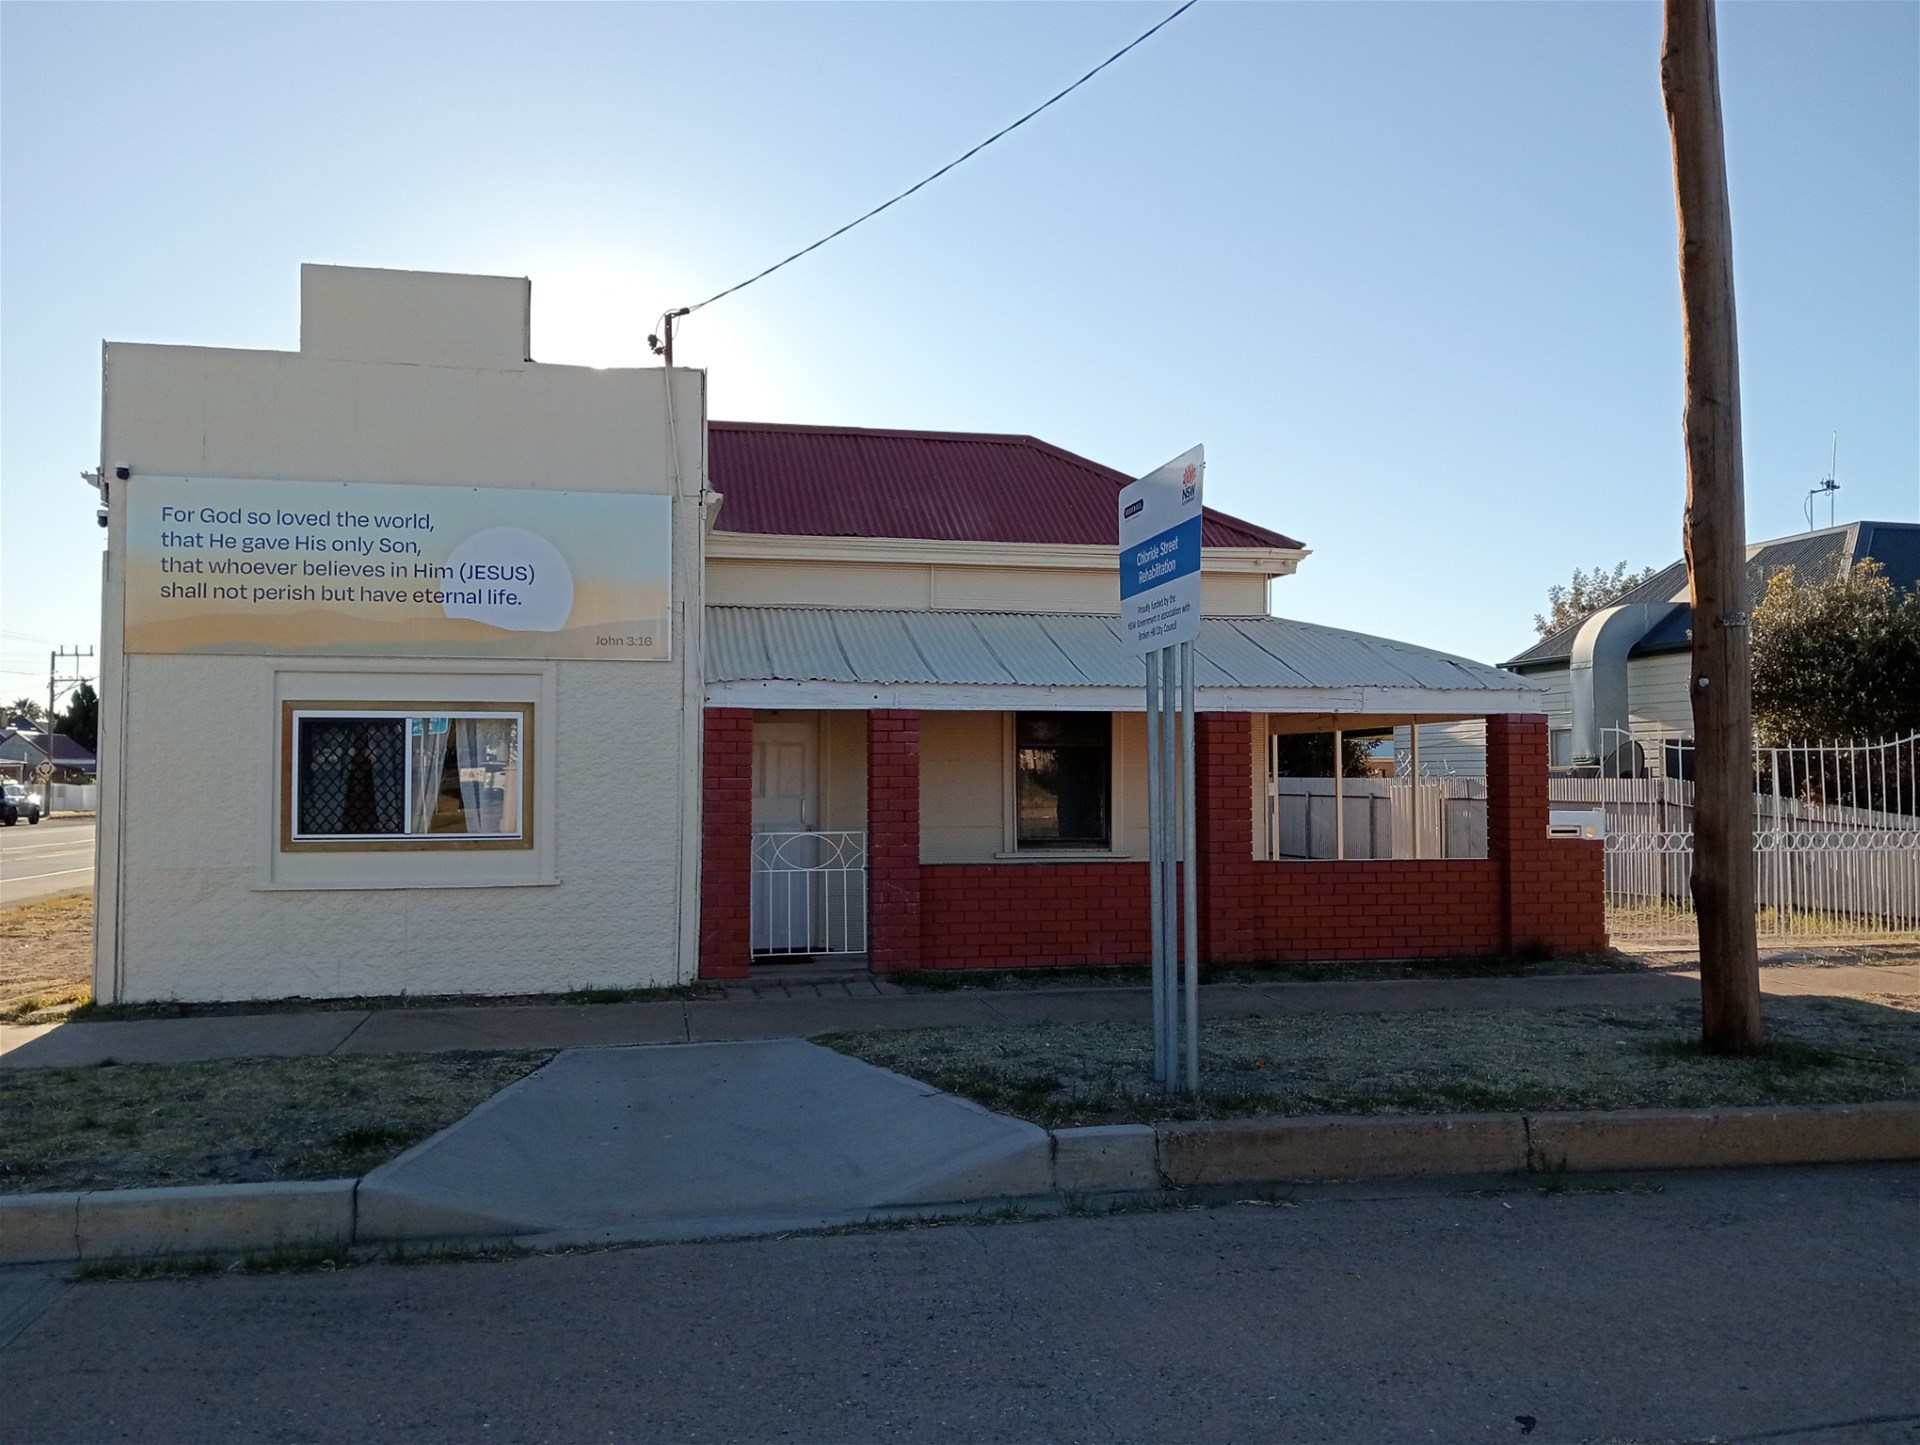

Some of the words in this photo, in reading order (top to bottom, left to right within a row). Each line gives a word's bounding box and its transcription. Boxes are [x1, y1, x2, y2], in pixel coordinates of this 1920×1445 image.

[1182, 483, 1196, 500] NSW
[162, 507, 196, 523] For
[199, 507, 242, 524] God
[247, 512, 272, 526] so
[276, 508, 331, 527] loved
[336, 510, 370, 528] the
[373, 512, 435, 533] world,
[161, 531, 205, 548] that
[209, 532, 237, 549] He
[241, 538, 290, 554] gave
[295, 534, 327, 552] His
[331, 536, 375, 557] only
[378, 537, 422, 558] Son,
[1137, 544, 1159, 566] Chloride
[1160, 536, 1179, 556] Street
[161, 556, 204, 573] that
[208, 558, 298, 575] whoever
[303, 559, 386, 577] believes
[390, 561, 408, 578] in
[413, 562, 454, 580] Him
[459, 562, 535, 586] (JESUS)
[1139, 559, 1176, 584] Rehabilitation
[160, 581, 207, 599] shall
[213, 584, 248, 600] not
[253, 584, 316, 604] perish
[321, 585, 356, 602] but
[360, 586, 408, 603] have
[413, 588, 482, 605] eternal
[487, 588, 523, 606] life.
[1138, 603, 1151, 614] Proudly
[1151, 598, 1163, 610] funded
[1164, 596, 1169, 606] by
[1137, 614, 1157, 628] Government
[1182, 602, 1191, 612] with
[1164, 621, 1177, 633] Council
[595, 635, 624, 647] John
[626, 636, 653, 647] 3:16
